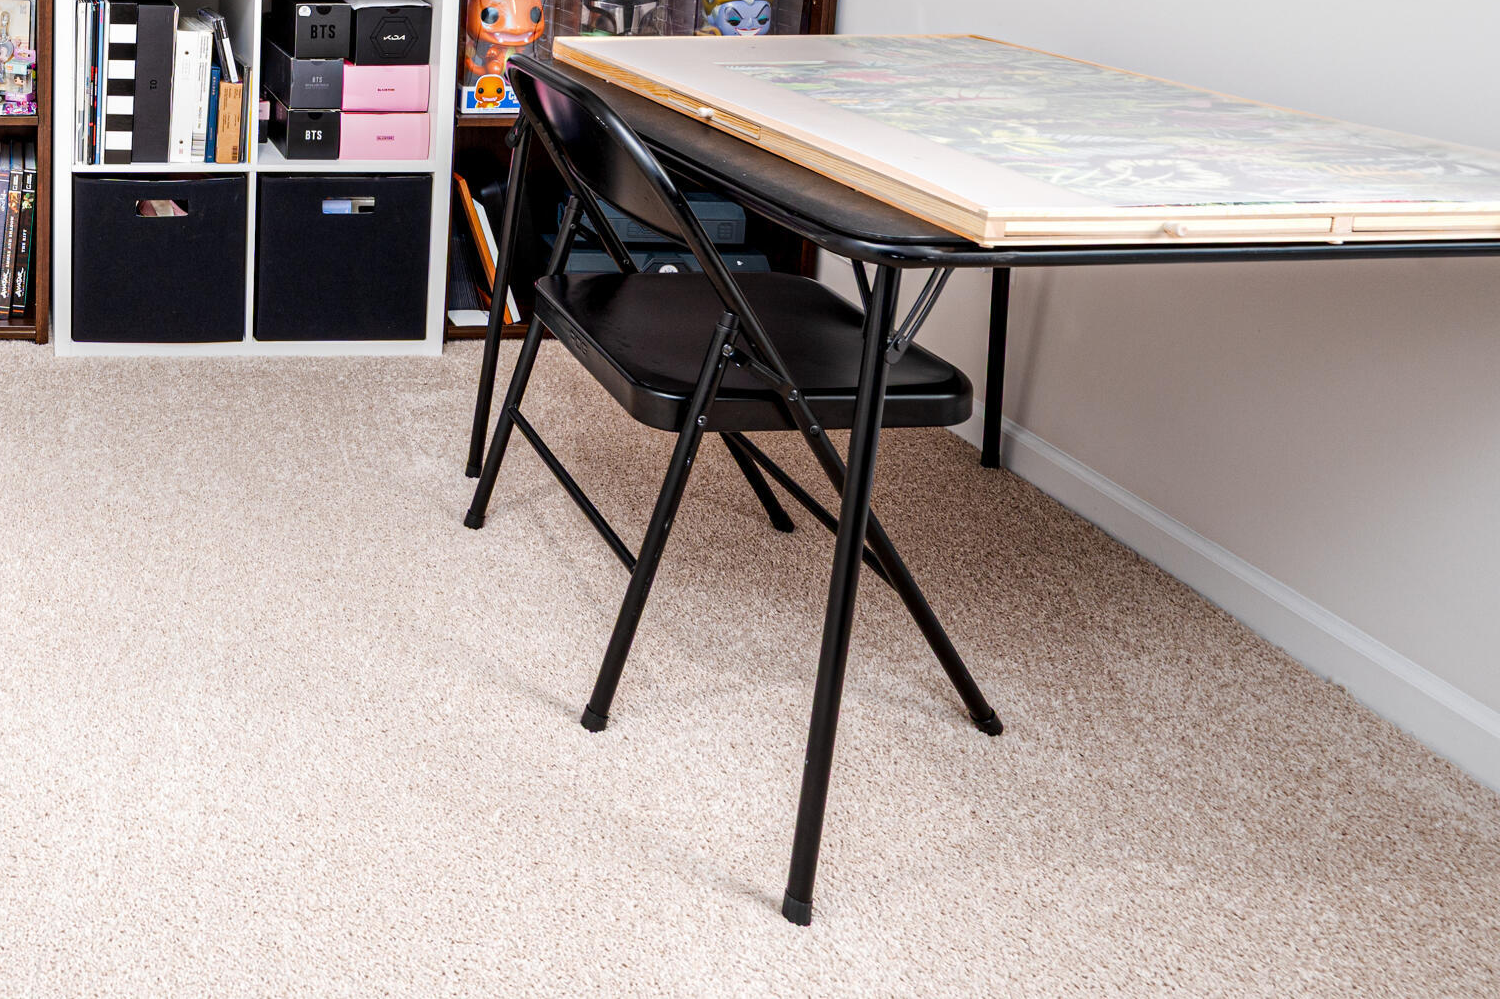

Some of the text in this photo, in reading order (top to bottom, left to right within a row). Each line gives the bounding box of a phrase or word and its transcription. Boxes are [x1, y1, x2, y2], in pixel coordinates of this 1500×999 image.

[310, 24, 336, 39] BTS
[149, 79, 158, 90] 01
[305, 130, 322, 140] BTS
